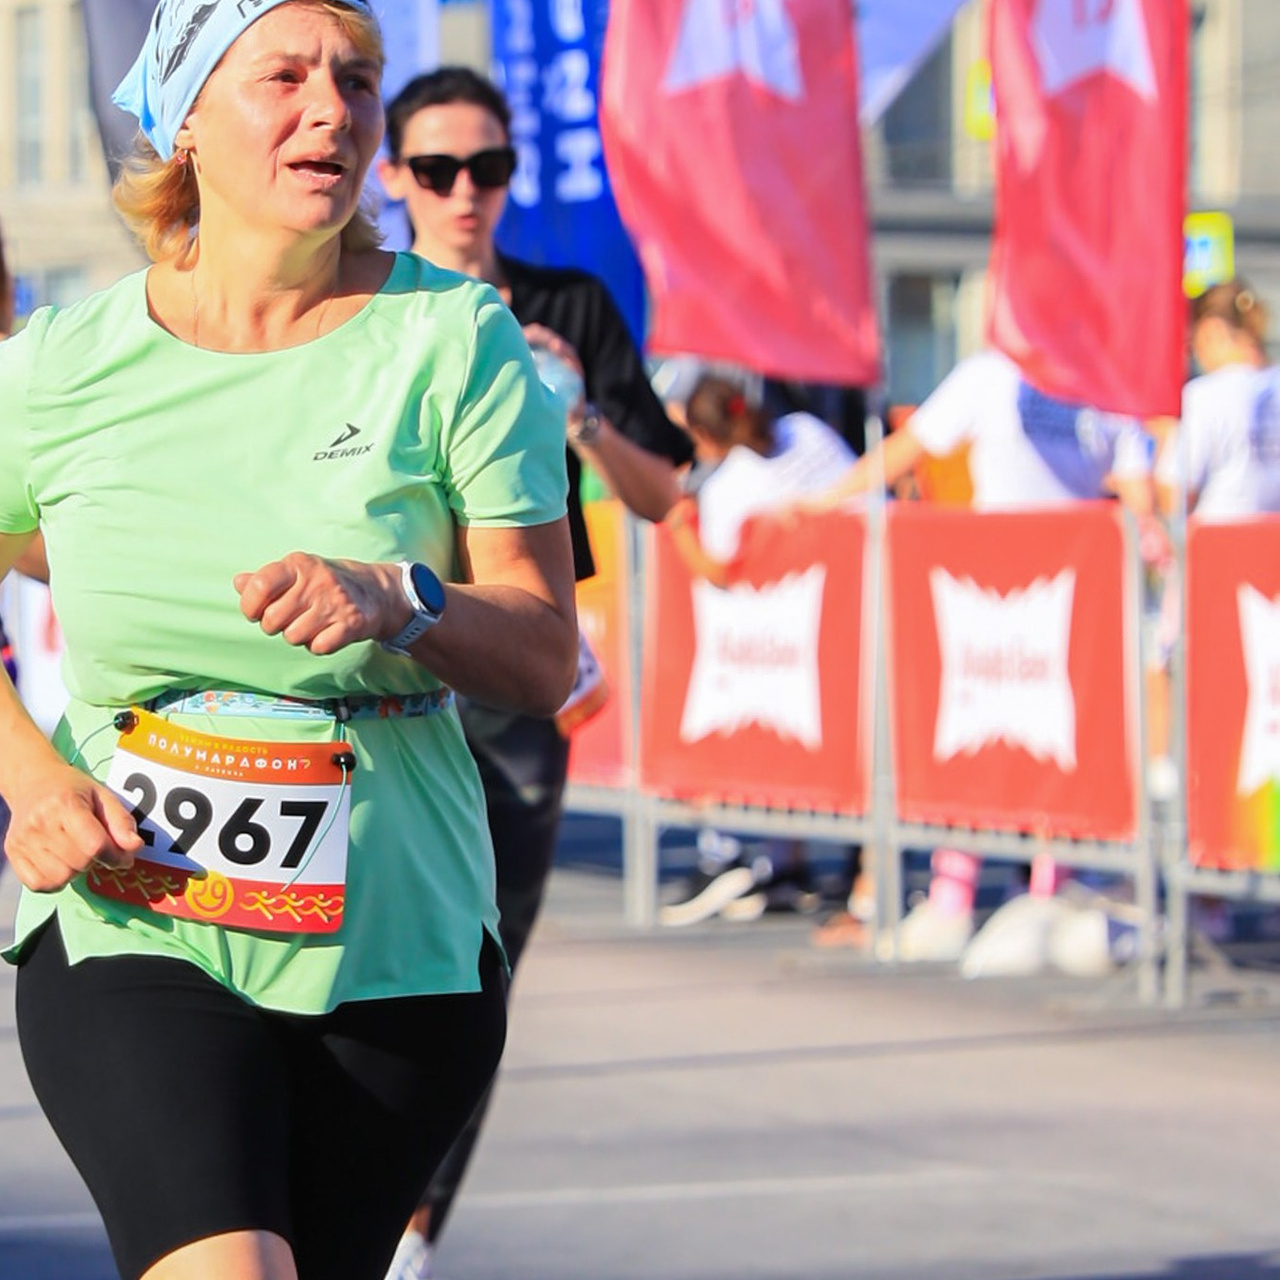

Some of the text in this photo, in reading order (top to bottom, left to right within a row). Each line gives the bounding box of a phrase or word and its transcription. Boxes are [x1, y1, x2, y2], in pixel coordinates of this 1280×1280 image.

[313, 443, 374, 461] DEMIX
[148, 734, 298, 771] ПОЛУМАРАФОН
[123, 772, 329, 868] 2967
